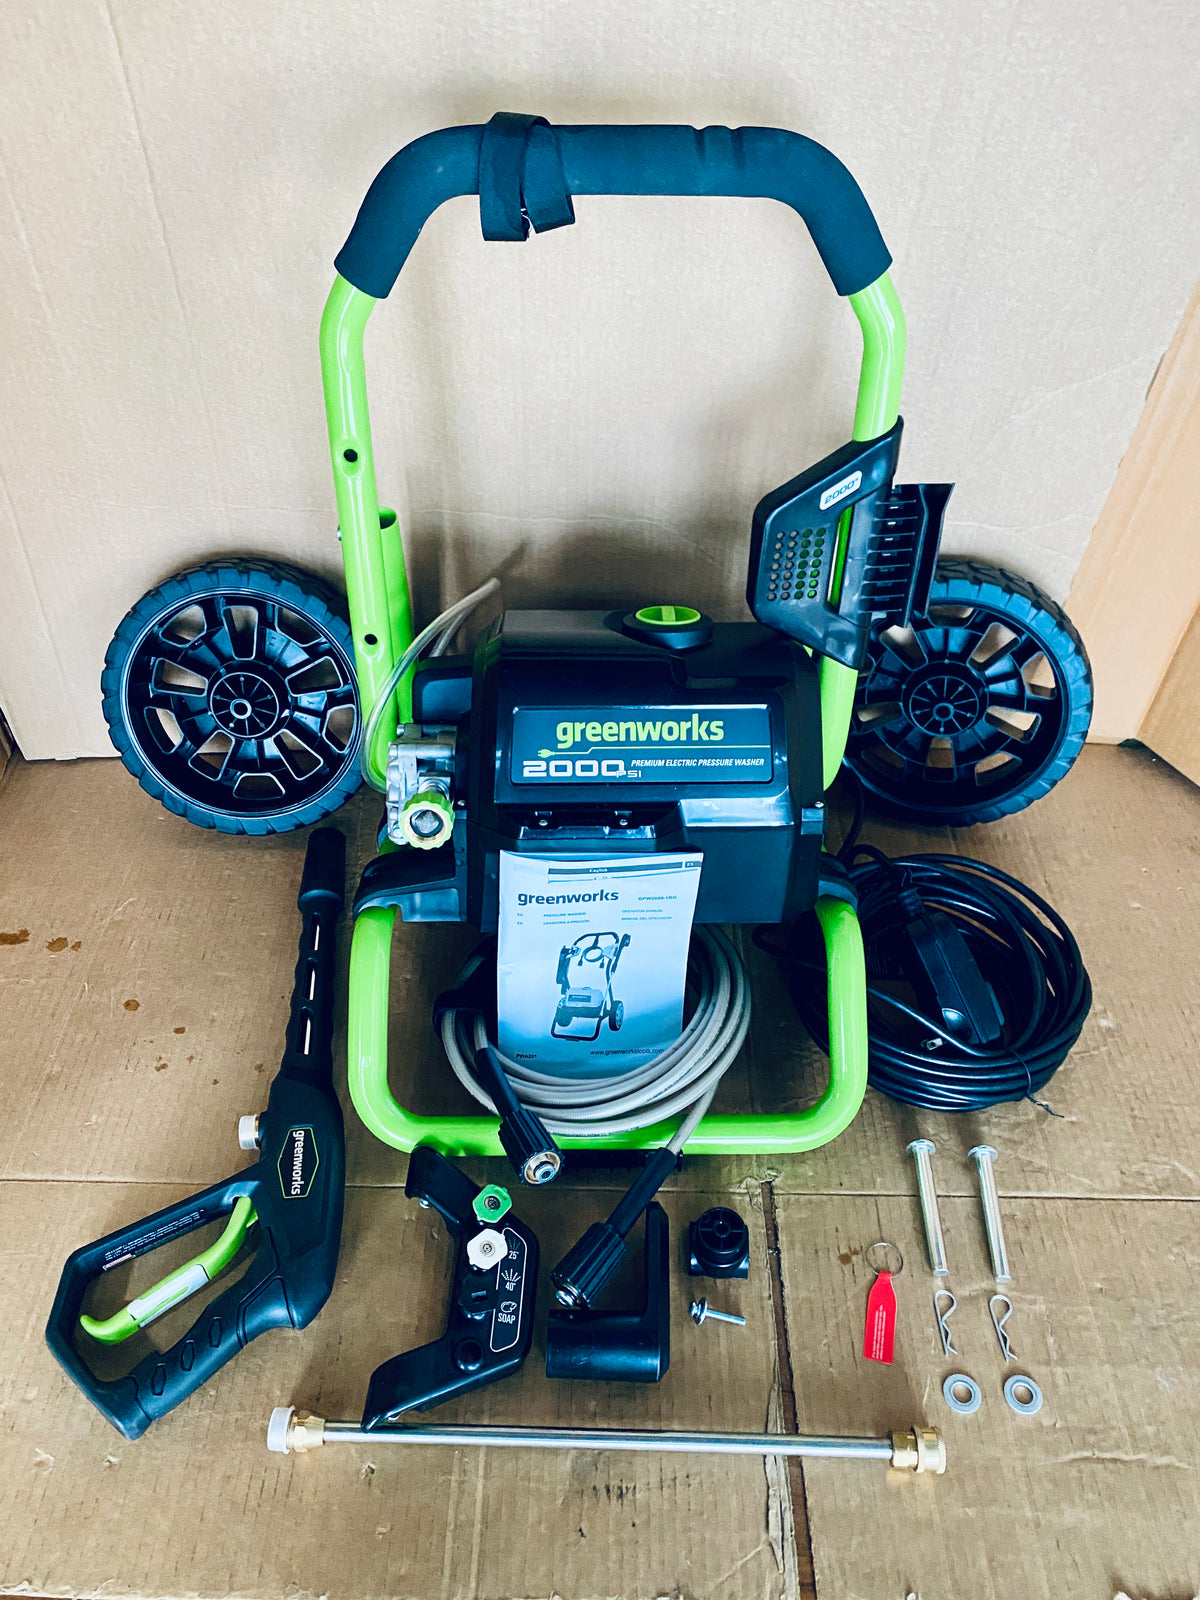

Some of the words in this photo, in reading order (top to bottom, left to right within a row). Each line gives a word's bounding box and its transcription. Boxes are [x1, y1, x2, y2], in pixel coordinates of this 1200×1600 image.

[556, 713, 724, 749] greenworks
[523, 760, 625, 777] 2000
[616, 770, 642, 778] PSI
[665, 759, 698, 767] ELECTRIC
[734, 758, 765, 766] WASHER
[517, 889, 619, 906] greenworks
[590, 1048, 665, 1056] www.greenworkstools.com
[291, 1130, 305, 1195] greenworks
[497, 1312, 516, 1324] SOAP
